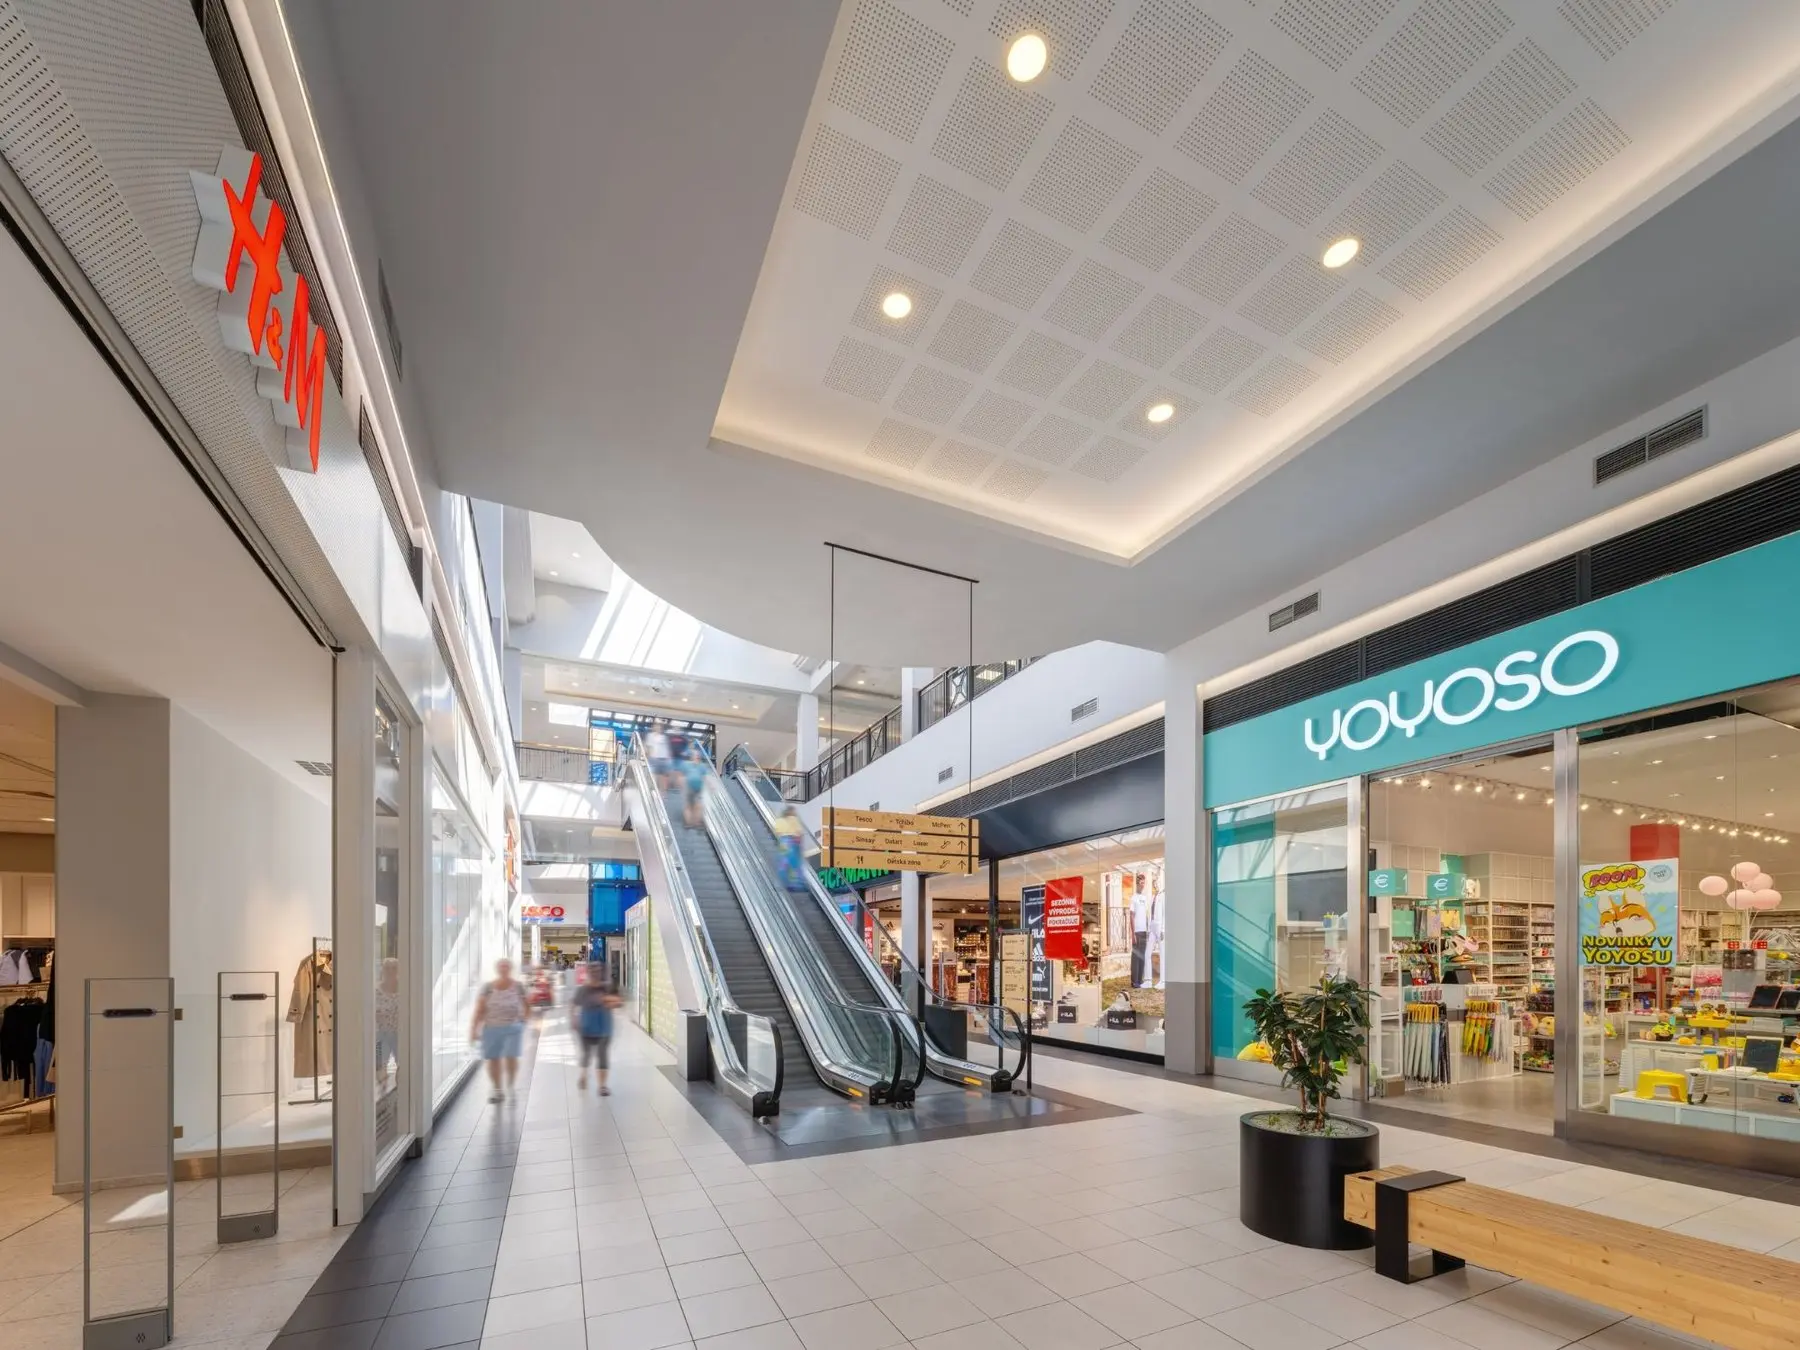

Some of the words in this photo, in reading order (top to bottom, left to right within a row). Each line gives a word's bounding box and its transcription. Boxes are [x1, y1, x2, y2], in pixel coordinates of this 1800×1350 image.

[222, 152, 328, 475] H&M
[1304, 631, 1619, 761] YOYOSO
[855, 815, 873, 823] Tesco
[895, 818, 915, 826] Tchibo
[855, 836, 875, 845] Sinsay
[1590, 867, 1638, 889] BOOM
[1582, 935, 1656, 948] NOVINKY
[1657, 935, 1673, 948] V
[1582, 947, 1673, 965] YOYOSU
